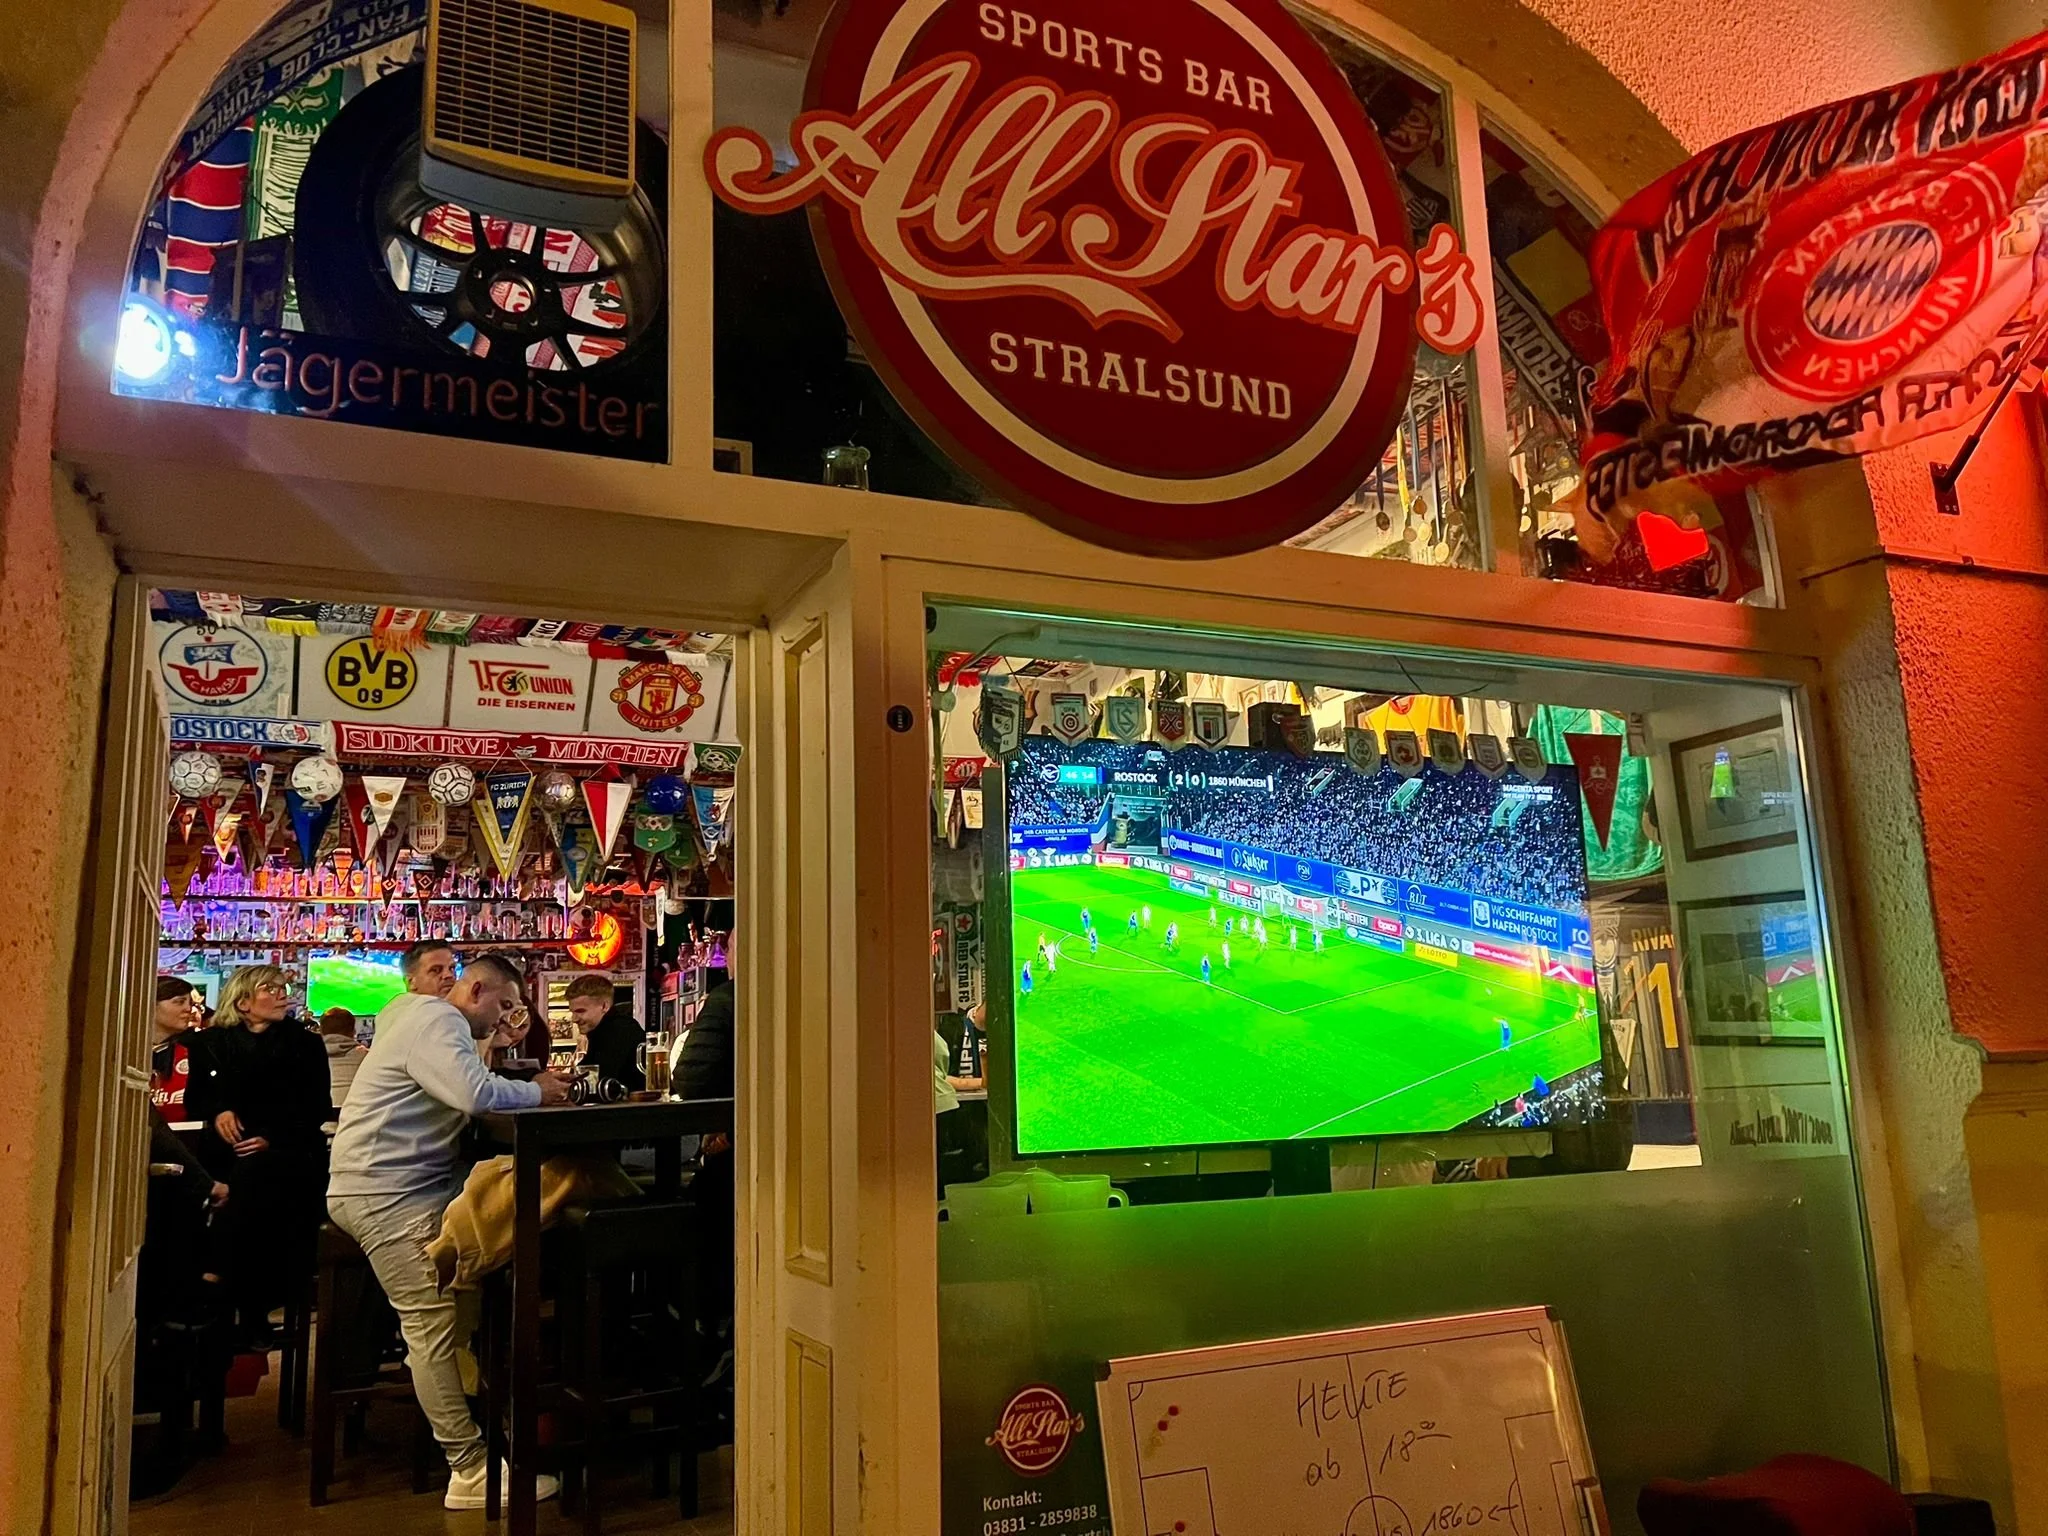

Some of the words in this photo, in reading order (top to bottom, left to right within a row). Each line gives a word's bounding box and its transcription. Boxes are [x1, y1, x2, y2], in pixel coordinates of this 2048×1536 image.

[977, 2, 1164, 84] SPORTS
[1185, 58, 1274, 116] BAR
[706, 54, 1118, 302] All
[216, 326, 660, 441] Jägermeister
[989, 332, 1293, 421] STRALSUND
[337, 642, 408, 690] BVB
[357, 687, 383, 704] 09
[530, 676, 574, 696] UNION
[477, 697, 501, 708] DIE
[505, 698, 576, 712] EISERNEN
[631, 714, 679, 727] UNITED
[349, 730, 501, 756] SÜDKURVE
[549, 740, 679, 766] MÜNCHEN
[1114, 772, 1158, 783] ROSTOCK
[1228, 776, 1268, 788] MÜNCHEN
[1492, 919, 1520, 935] HAFEN
[1506, 906, 1558, 928] SCHIFFAHRT
[957, 941, 969, 961] RED
[958, 963, 969, 988] STAR
[958, 991, 970, 1003] FC
[1297, 1369, 1408, 1438] HEUTE
[1306, 1448, 1341, 1487] ab
[983, 1490, 1043, 1512] Kontakt:
[983, 1515, 1027, 1536] 03831
[1039, 1504, 1098, 1527] 2859838
[1420, 1502, 1484, 1536] 1860
